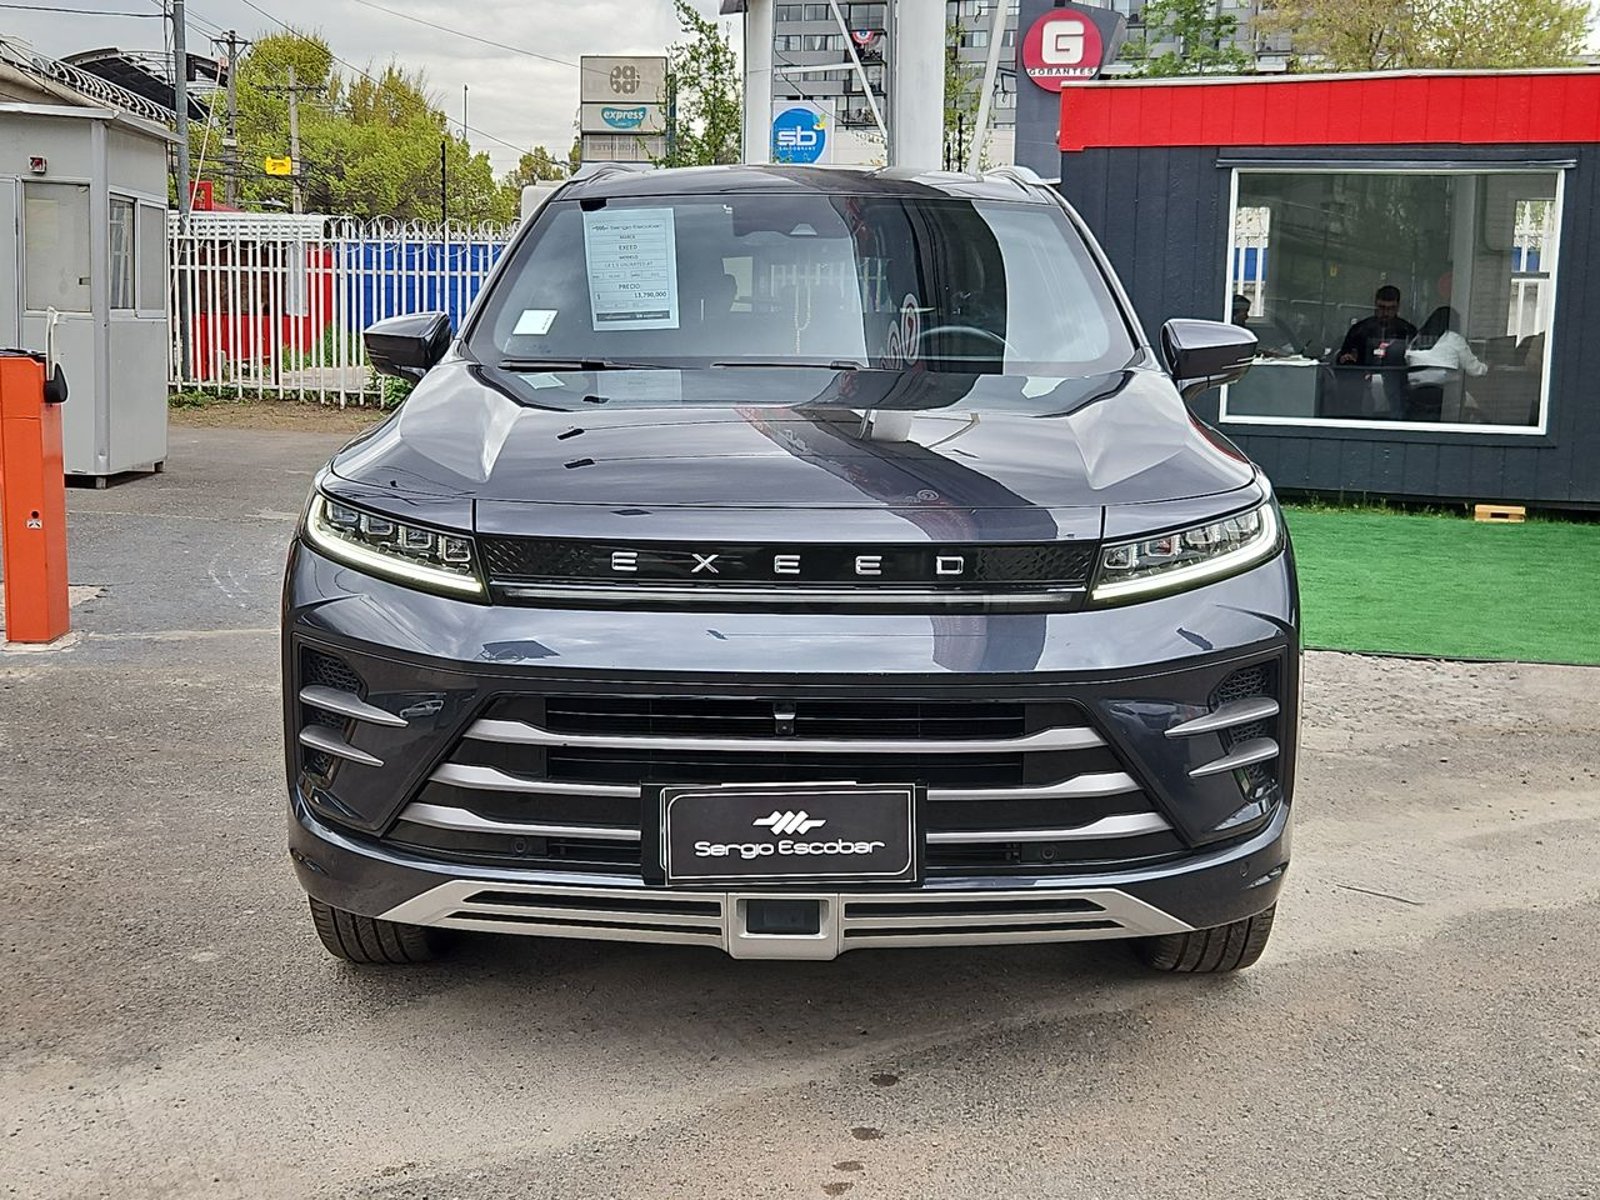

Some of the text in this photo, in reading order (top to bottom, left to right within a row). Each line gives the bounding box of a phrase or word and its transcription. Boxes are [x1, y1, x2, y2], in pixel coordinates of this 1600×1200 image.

[1041, 20, 1085, 65] G
[1028, 67, 1094, 76] GOBANTES
[603, 109, 644, 122] express
[777, 125, 817, 146] sb
[611, 551, 964, 575] EXEED
[694, 839, 886, 860] Sergio Escobar
